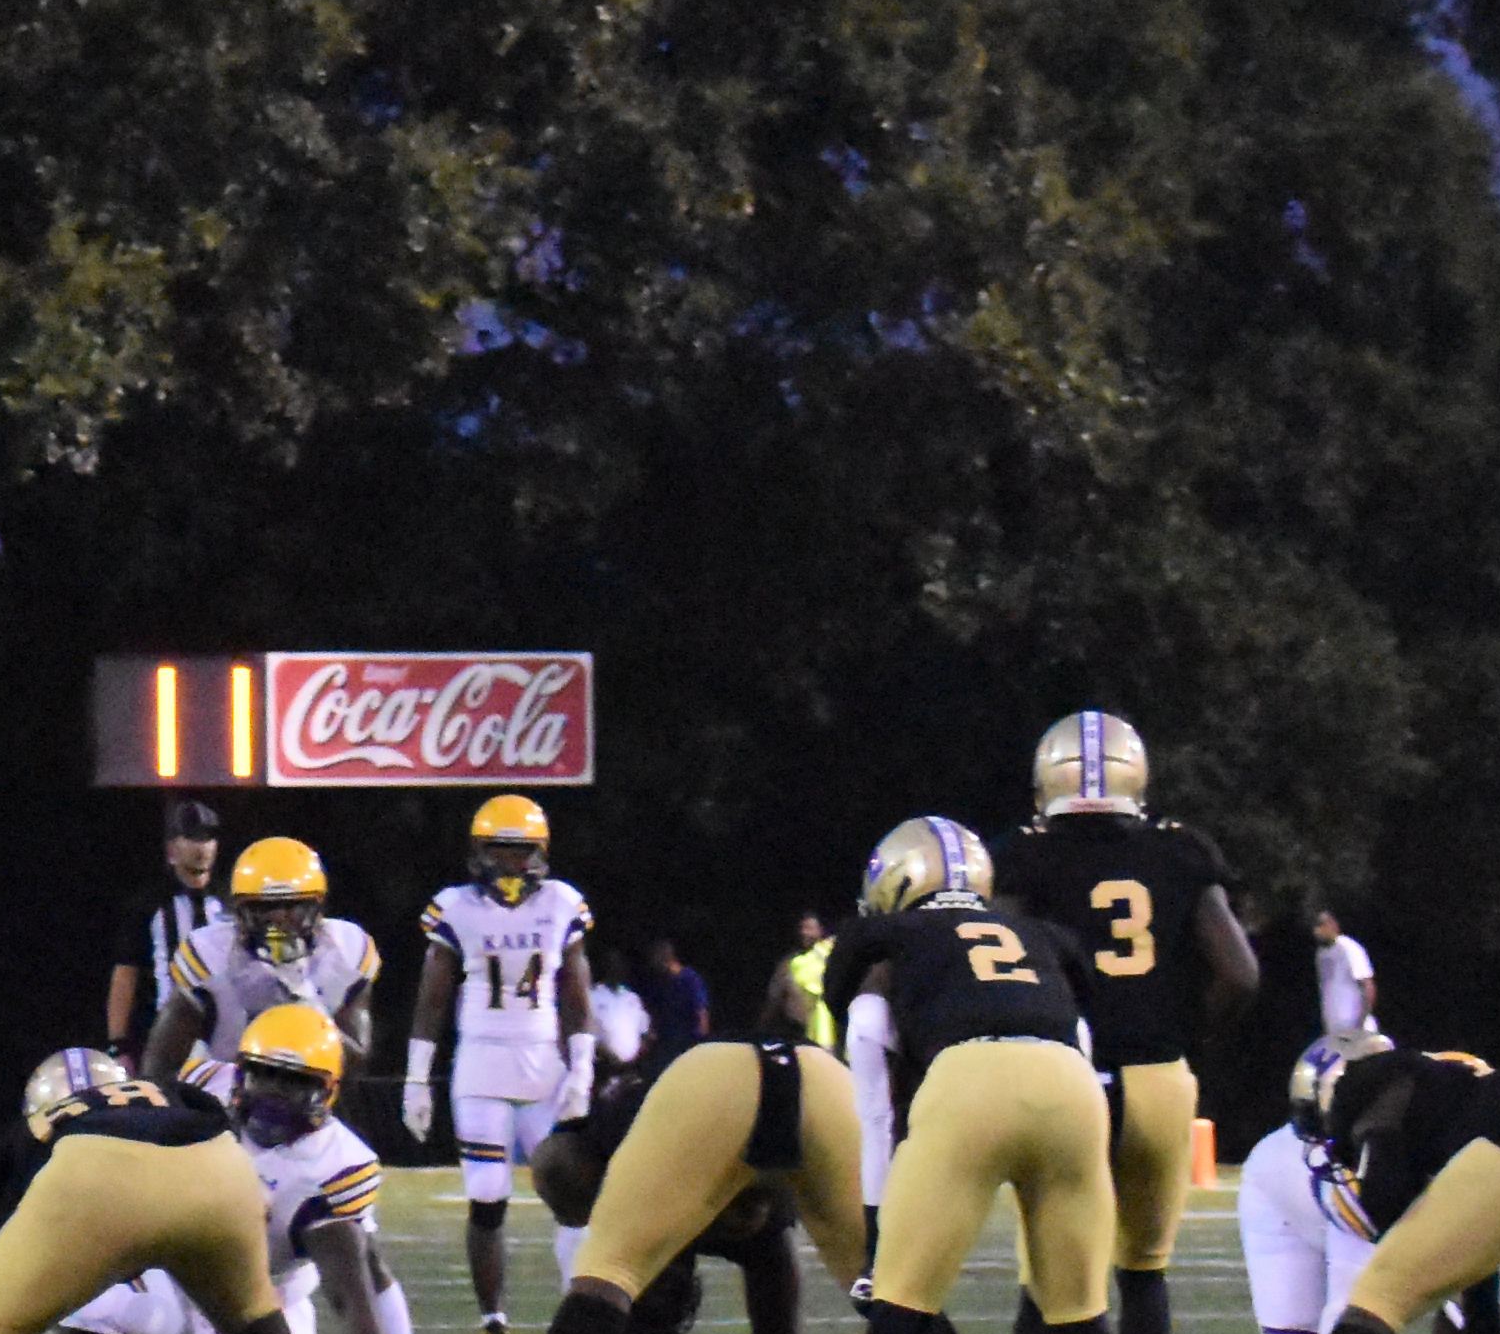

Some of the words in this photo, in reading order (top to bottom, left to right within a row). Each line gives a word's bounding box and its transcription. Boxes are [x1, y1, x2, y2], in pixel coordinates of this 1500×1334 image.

[281, 663, 576, 769] Coca-Cola
[956, 921, 1040, 984] 2
[1090, 879, 1157, 977] 3
[485, 952, 544, 1010] 14
